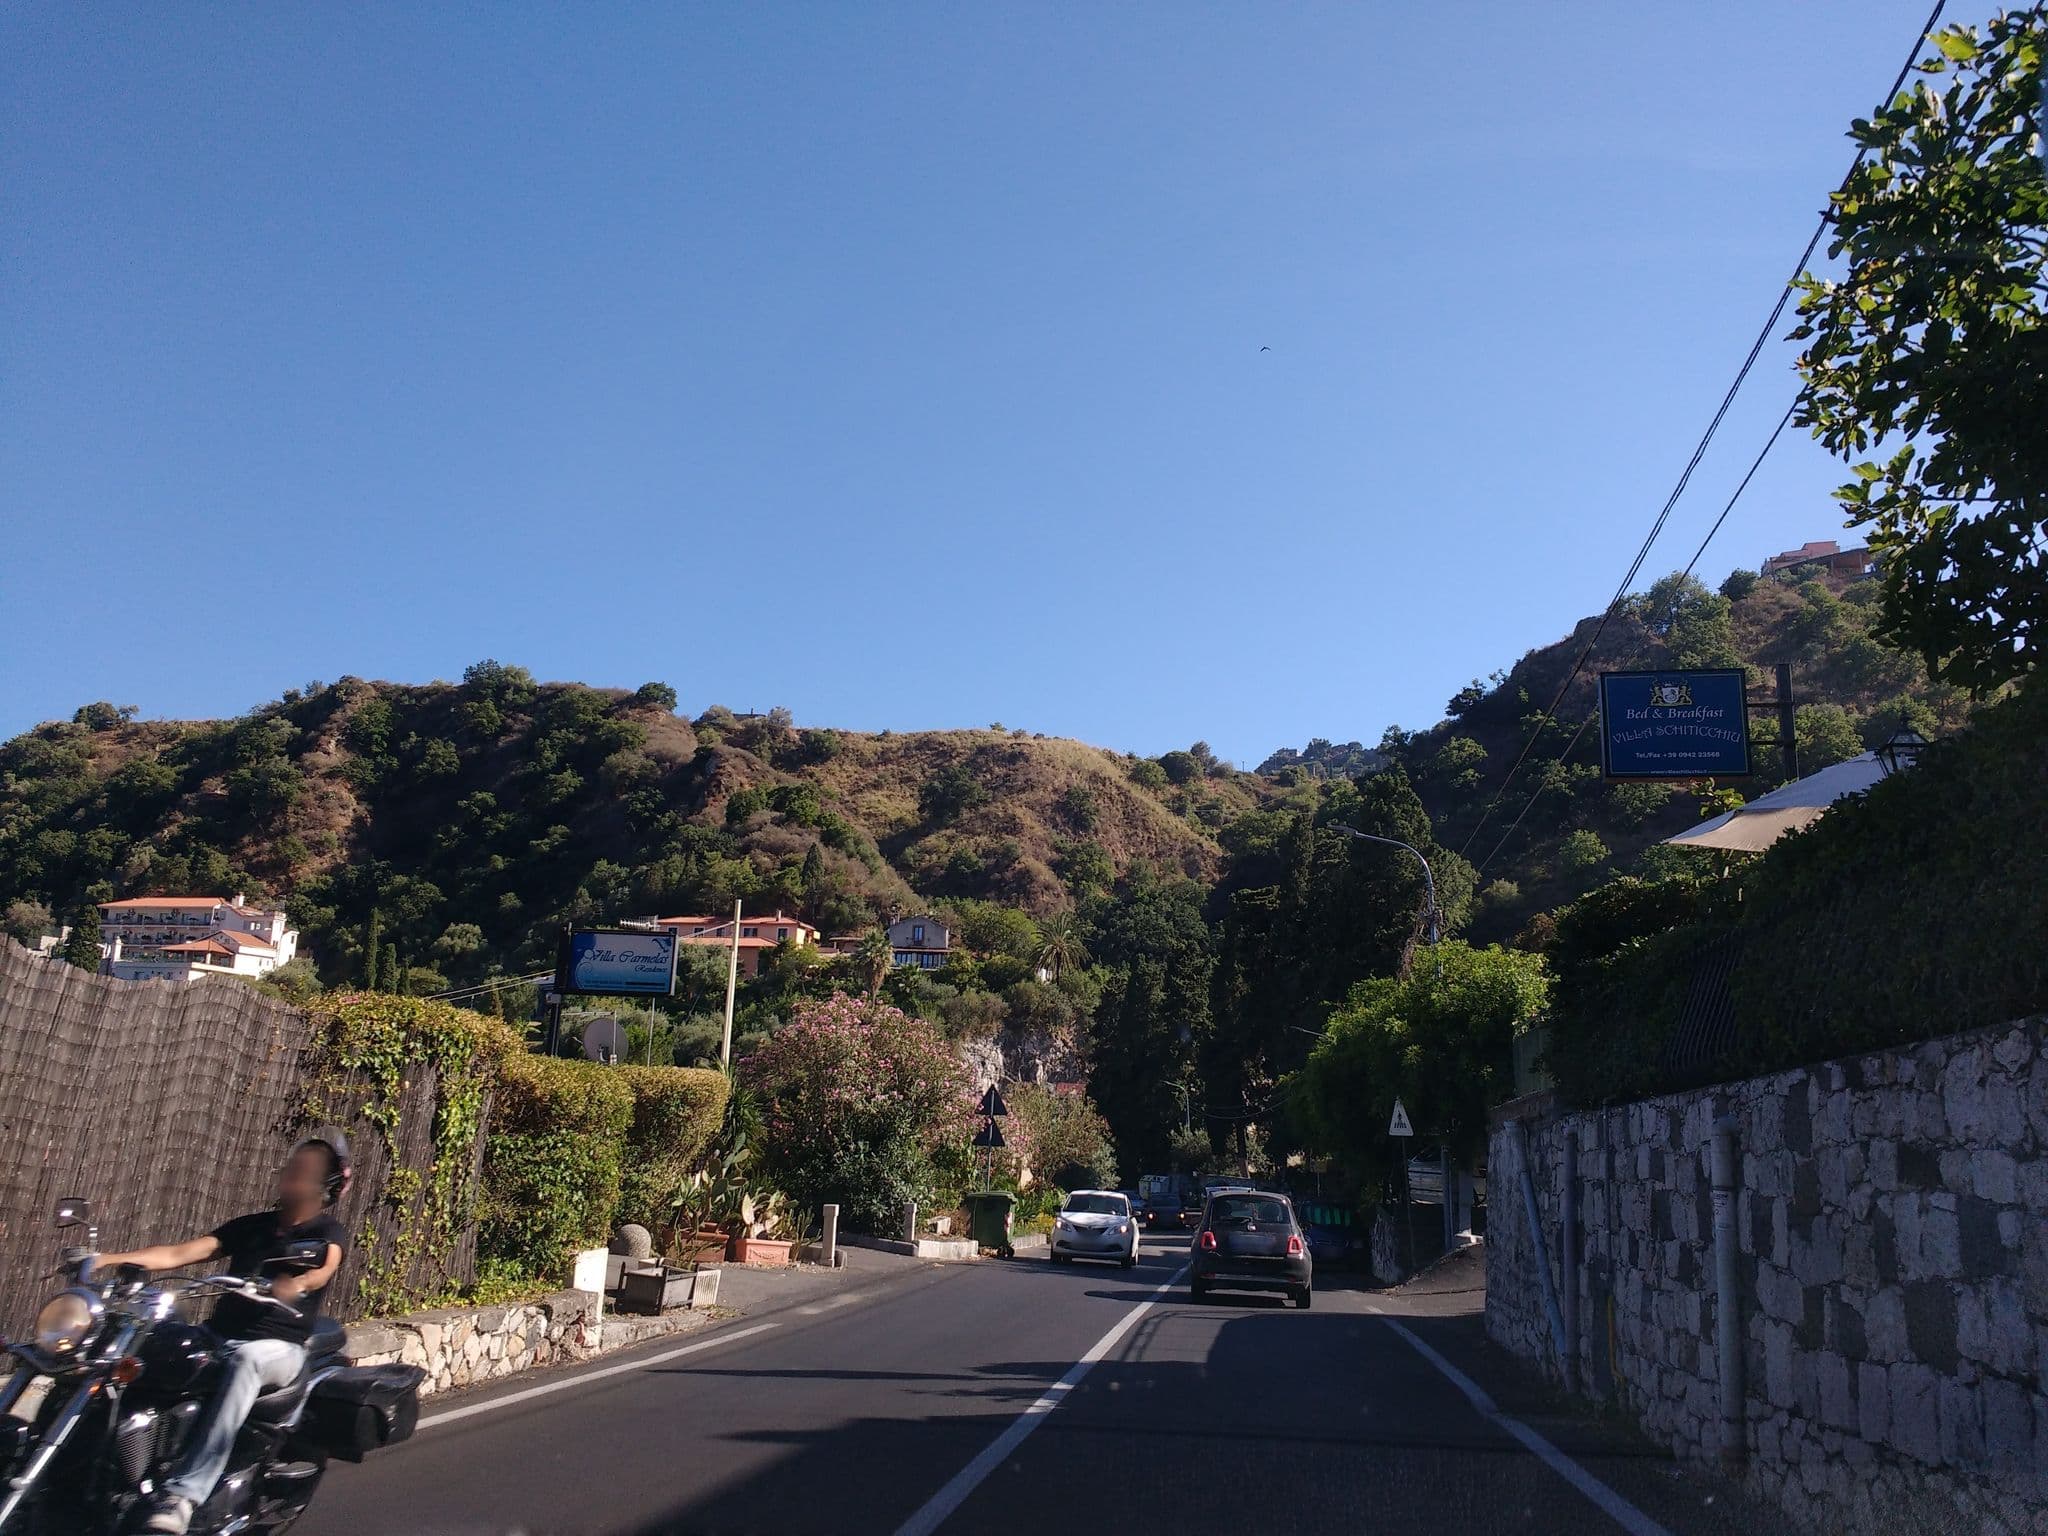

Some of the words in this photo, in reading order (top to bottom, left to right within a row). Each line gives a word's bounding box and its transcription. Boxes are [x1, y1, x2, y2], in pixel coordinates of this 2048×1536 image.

[1626, 707, 1649, 719] Bed
[1652, 709, 1663, 719] &
[1668, 706, 1723, 722] Breakfast
[1613, 728, 1652, 744] VILLA
[1656, 724, 1741, 743] SCHITICCHIU
[589, 950, 615, 963] Villa
